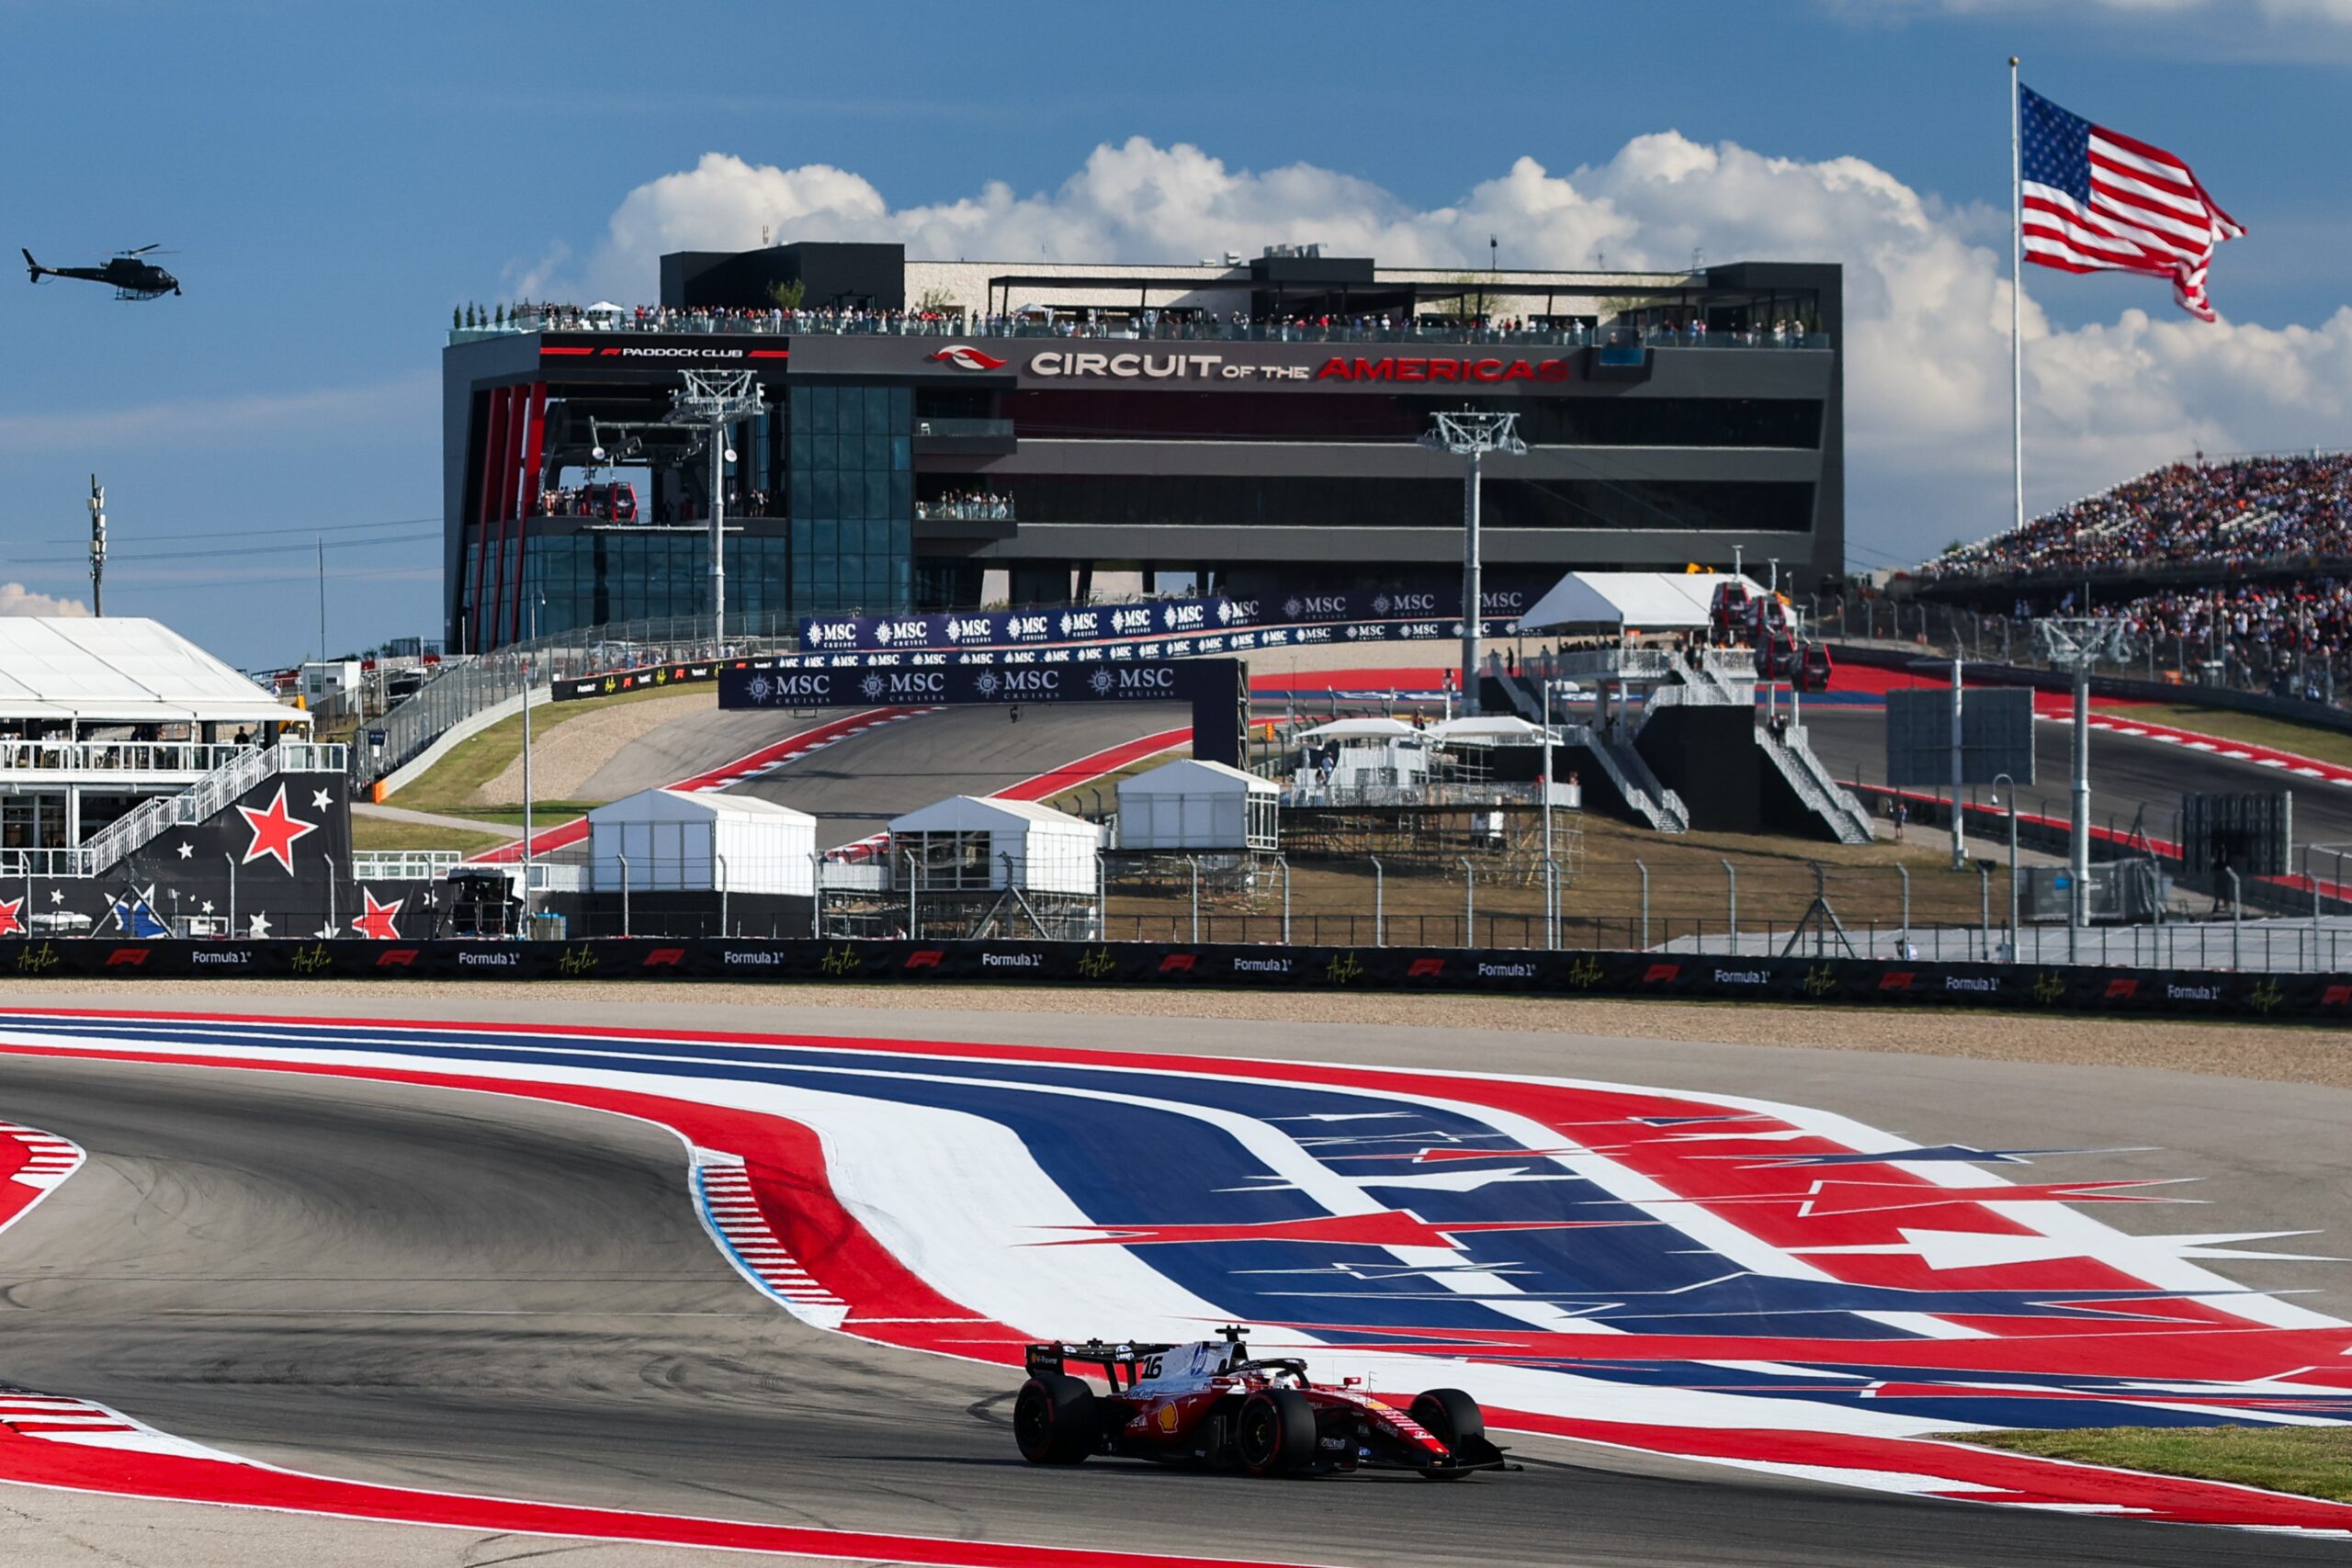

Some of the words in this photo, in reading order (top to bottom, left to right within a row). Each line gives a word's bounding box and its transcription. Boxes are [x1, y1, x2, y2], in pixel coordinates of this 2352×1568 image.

[622, 347, 699, 357] PADDOCK
[701, 349, 742, 358] CLUB
[1031, 352, 1222, 378] CIRCUIT
[1222, 365, 1253, 378] OF
[1261, 366, 1309, 379] THE
[1317, 356, 1571, 382] AMERICAS
[1305, 597, 1346, 613] MSC
[1393, 594, 1434, 610] MSC
[1483, 592, 1523, 608] MSC
[1177, 605, 1204, 623] MSC
[1231, 600, 1259, 617] MSC
[1072, 613, 1098, 630] MSC
[1125, 609, 1150, 626] MSC
[893, 621, 927, 638] MSC
[961, 618, 991, 636] MSC
[1022, 616, 1047, 633] MSC
[1359, 626, 1385, 636] MSC
[1411, 624, 1438, 634] MSC
[823, 623, 856, 640] MSC
[1269, 630, 1286, 642] MSC
[1306, 628, 1330, 639] MSC
[1173, 640, 1191, 652] MSC
[1205, 637, 1223, 649] MSC
[1238, 634, 1255, 646] MSC
[878, 654, 900, 665] MSC
[924, 654, 946, 665] MSC
[971, 652, 993, 664] MSC
[1014, 651, 1035, 663] MSC
[1053, 649, 1069, 661] MSC
[1086, 649, 1102, 660] MSC
[841, 656, 858, 667] MSC
[889, 672, 944, 693] MSC
[1004, 671, 1059, 689] MSC
[1119, 668, 1174, 687] MSC
[775, 675, 831, 694] MSC
[192, 952, 238, 963] Formula
[458, 952, 507, 964] Formula
[724, 952, 772, 964] Formula
[982, 953, 1031, 965] Formula
[1234, 958, 1281, 971] Formula
[1478, 963, 1525, 976] Formula
[1714, 968, 1759, 983] Formula
[1946, 976, 1989, 990] Formula
[2167, 985, 2211, 999] Formula
[1142, 1356, 1162, 1379] 16
